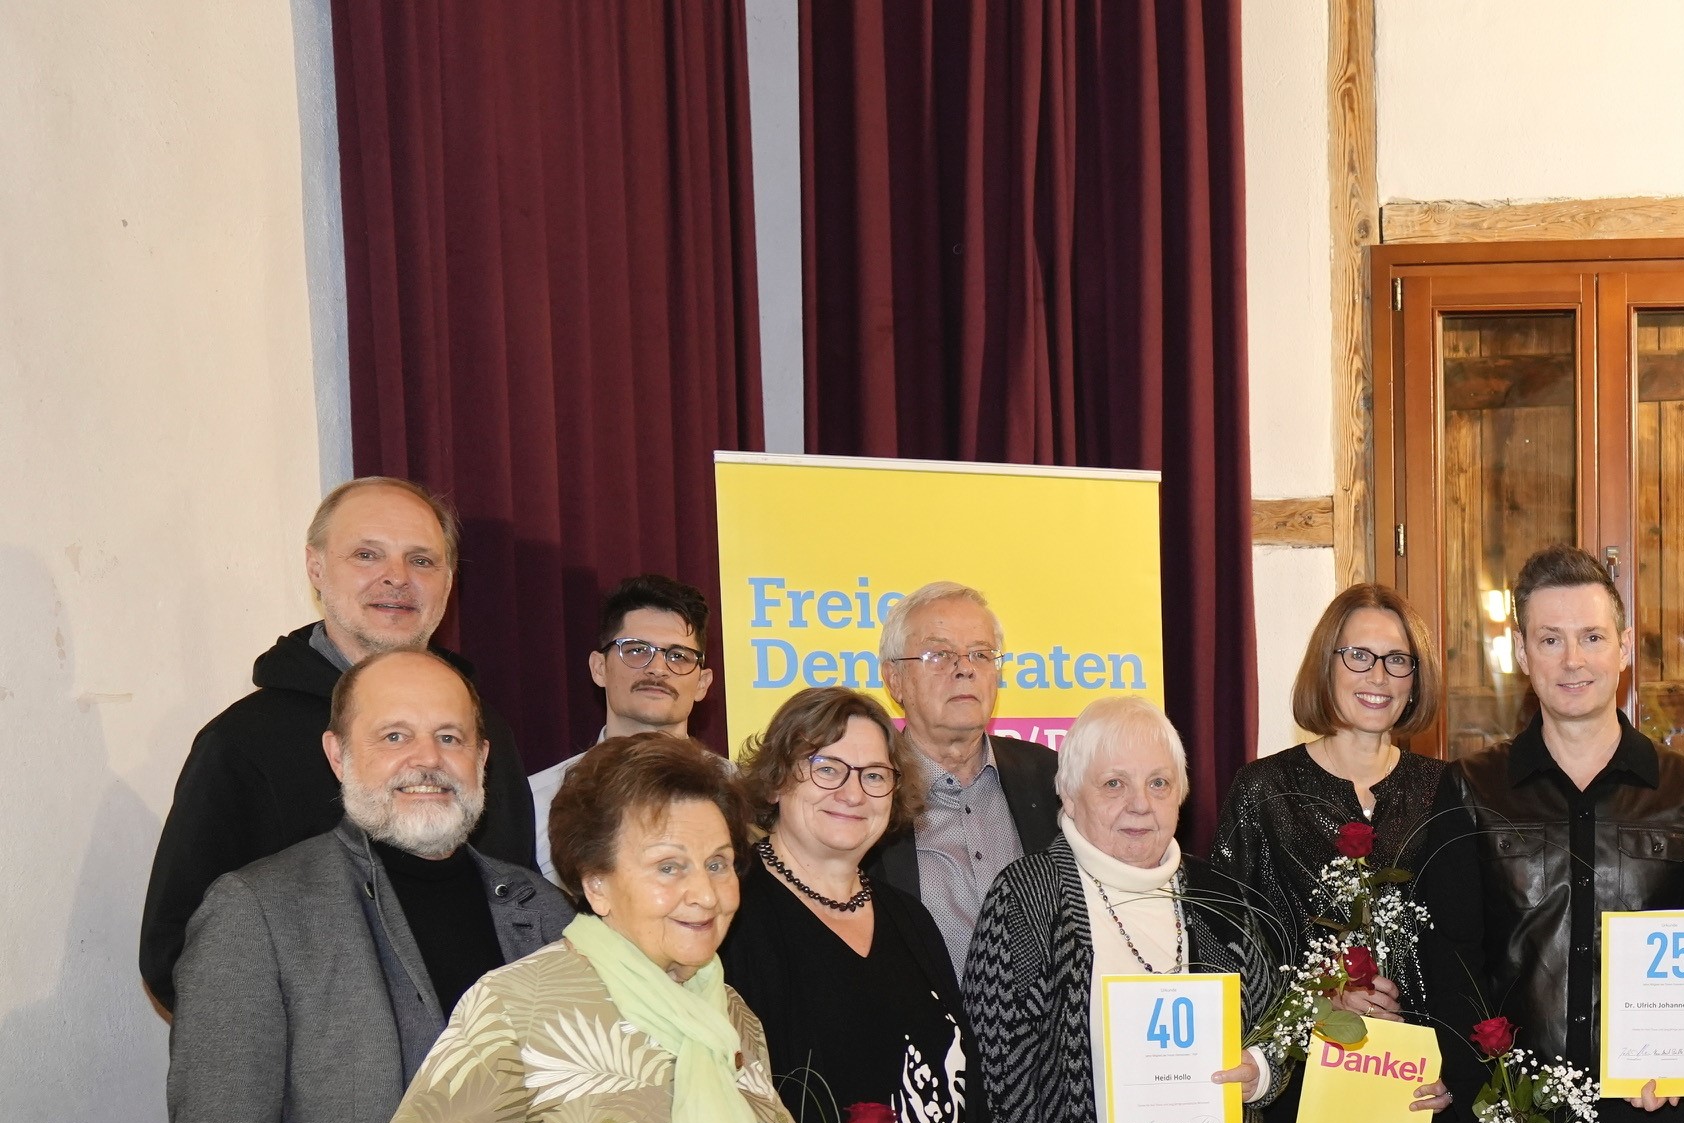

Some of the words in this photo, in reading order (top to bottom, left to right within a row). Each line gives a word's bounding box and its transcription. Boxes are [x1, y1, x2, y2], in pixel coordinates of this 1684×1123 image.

[1624, 1001, 1635, 1009] Dr.
[1146, 996, 1195, 1049] 40
[1320, 1040, 1427, 1083] Danke!
[1154, 1074, 1173, 1082] Heidi
[1173, 1073, 1192, 1081] Hollo
